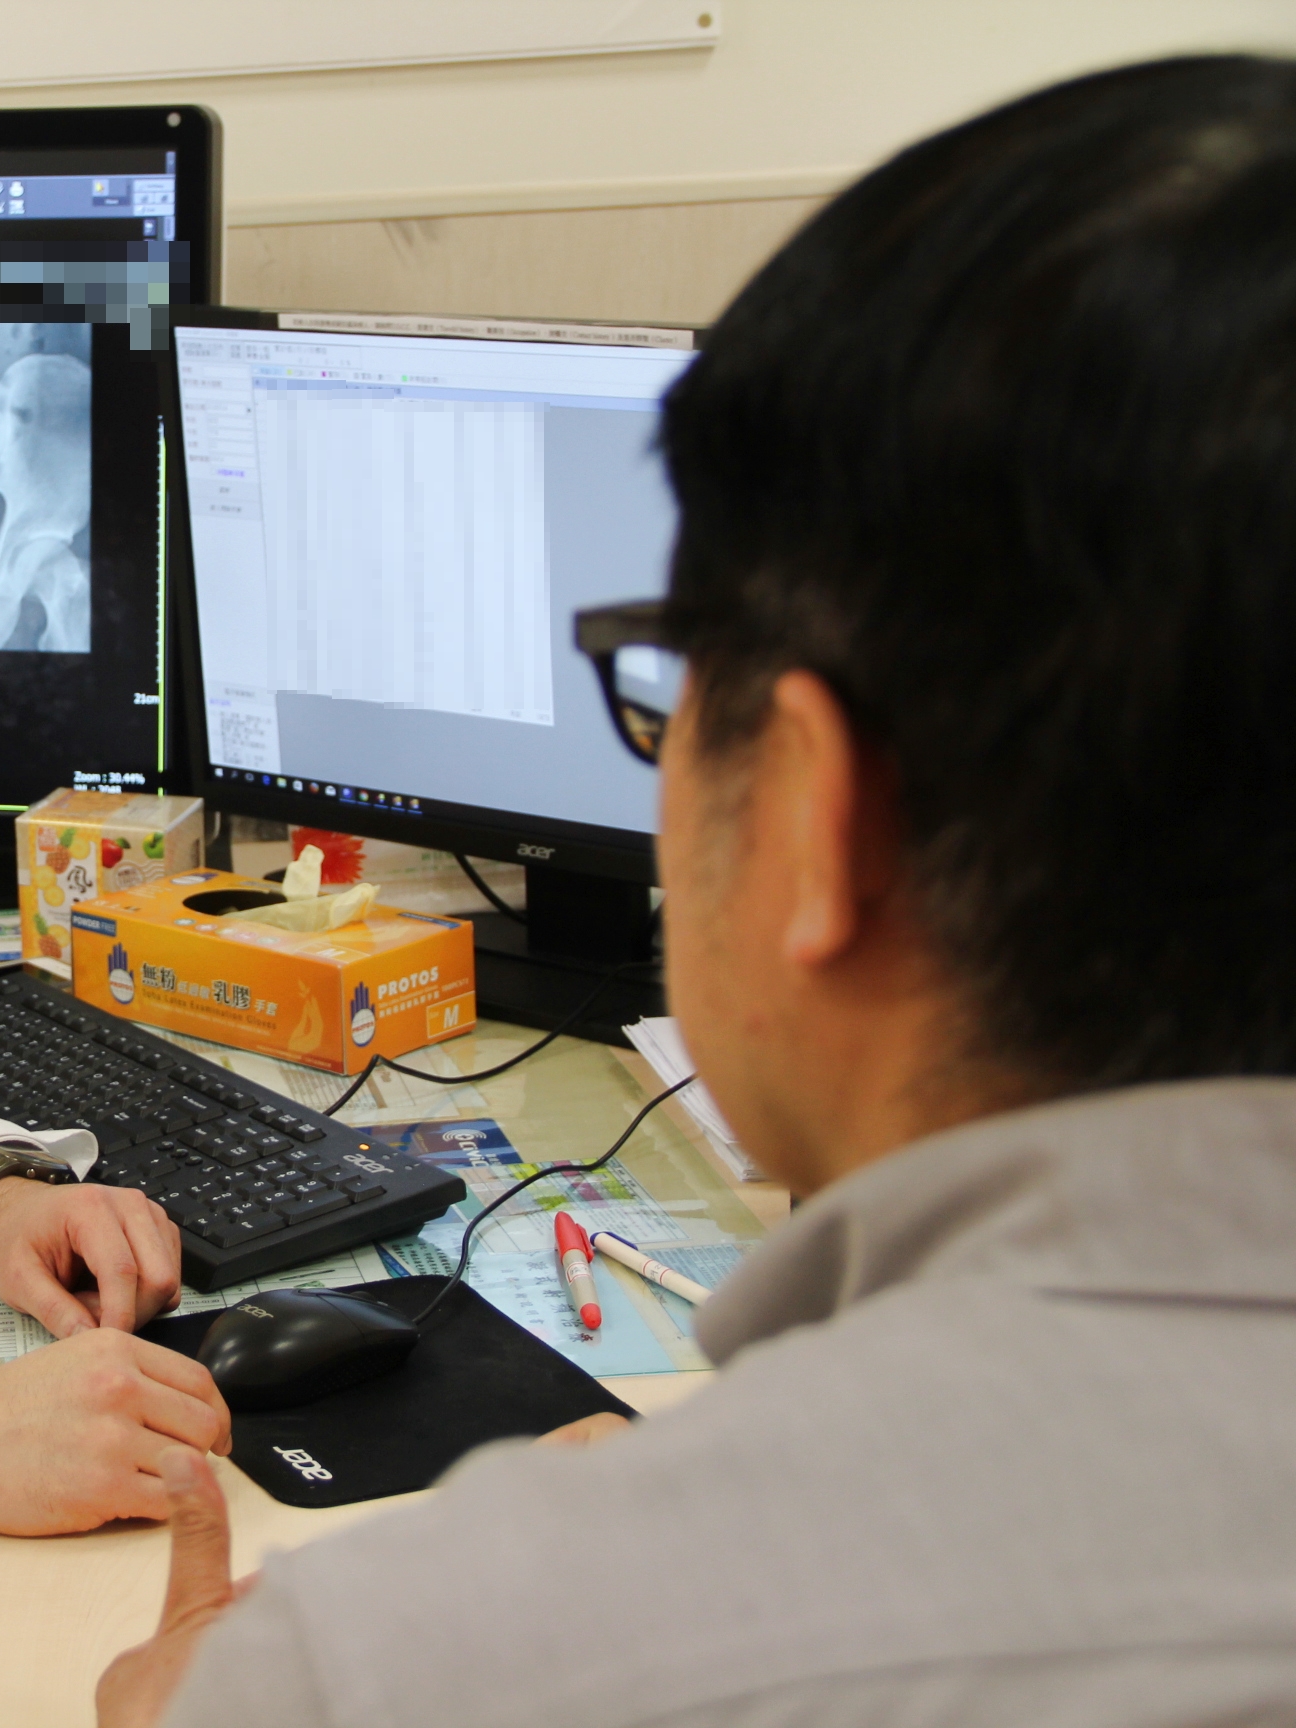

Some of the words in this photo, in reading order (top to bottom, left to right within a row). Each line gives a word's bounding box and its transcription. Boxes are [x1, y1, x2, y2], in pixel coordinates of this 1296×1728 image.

[73, 770, 101, 783] Zoom
[516, 843, 556, 860] acer
[73, 915, 101, 929] POWDER
[377, 966, 439, 1000] PROTOS
[443, 1003, 460, 1029] M
[342, 1153, 395, 1174] acer
[236, 1303, 274, 1319] acer
[272, 1445, 333, 1480] acer
